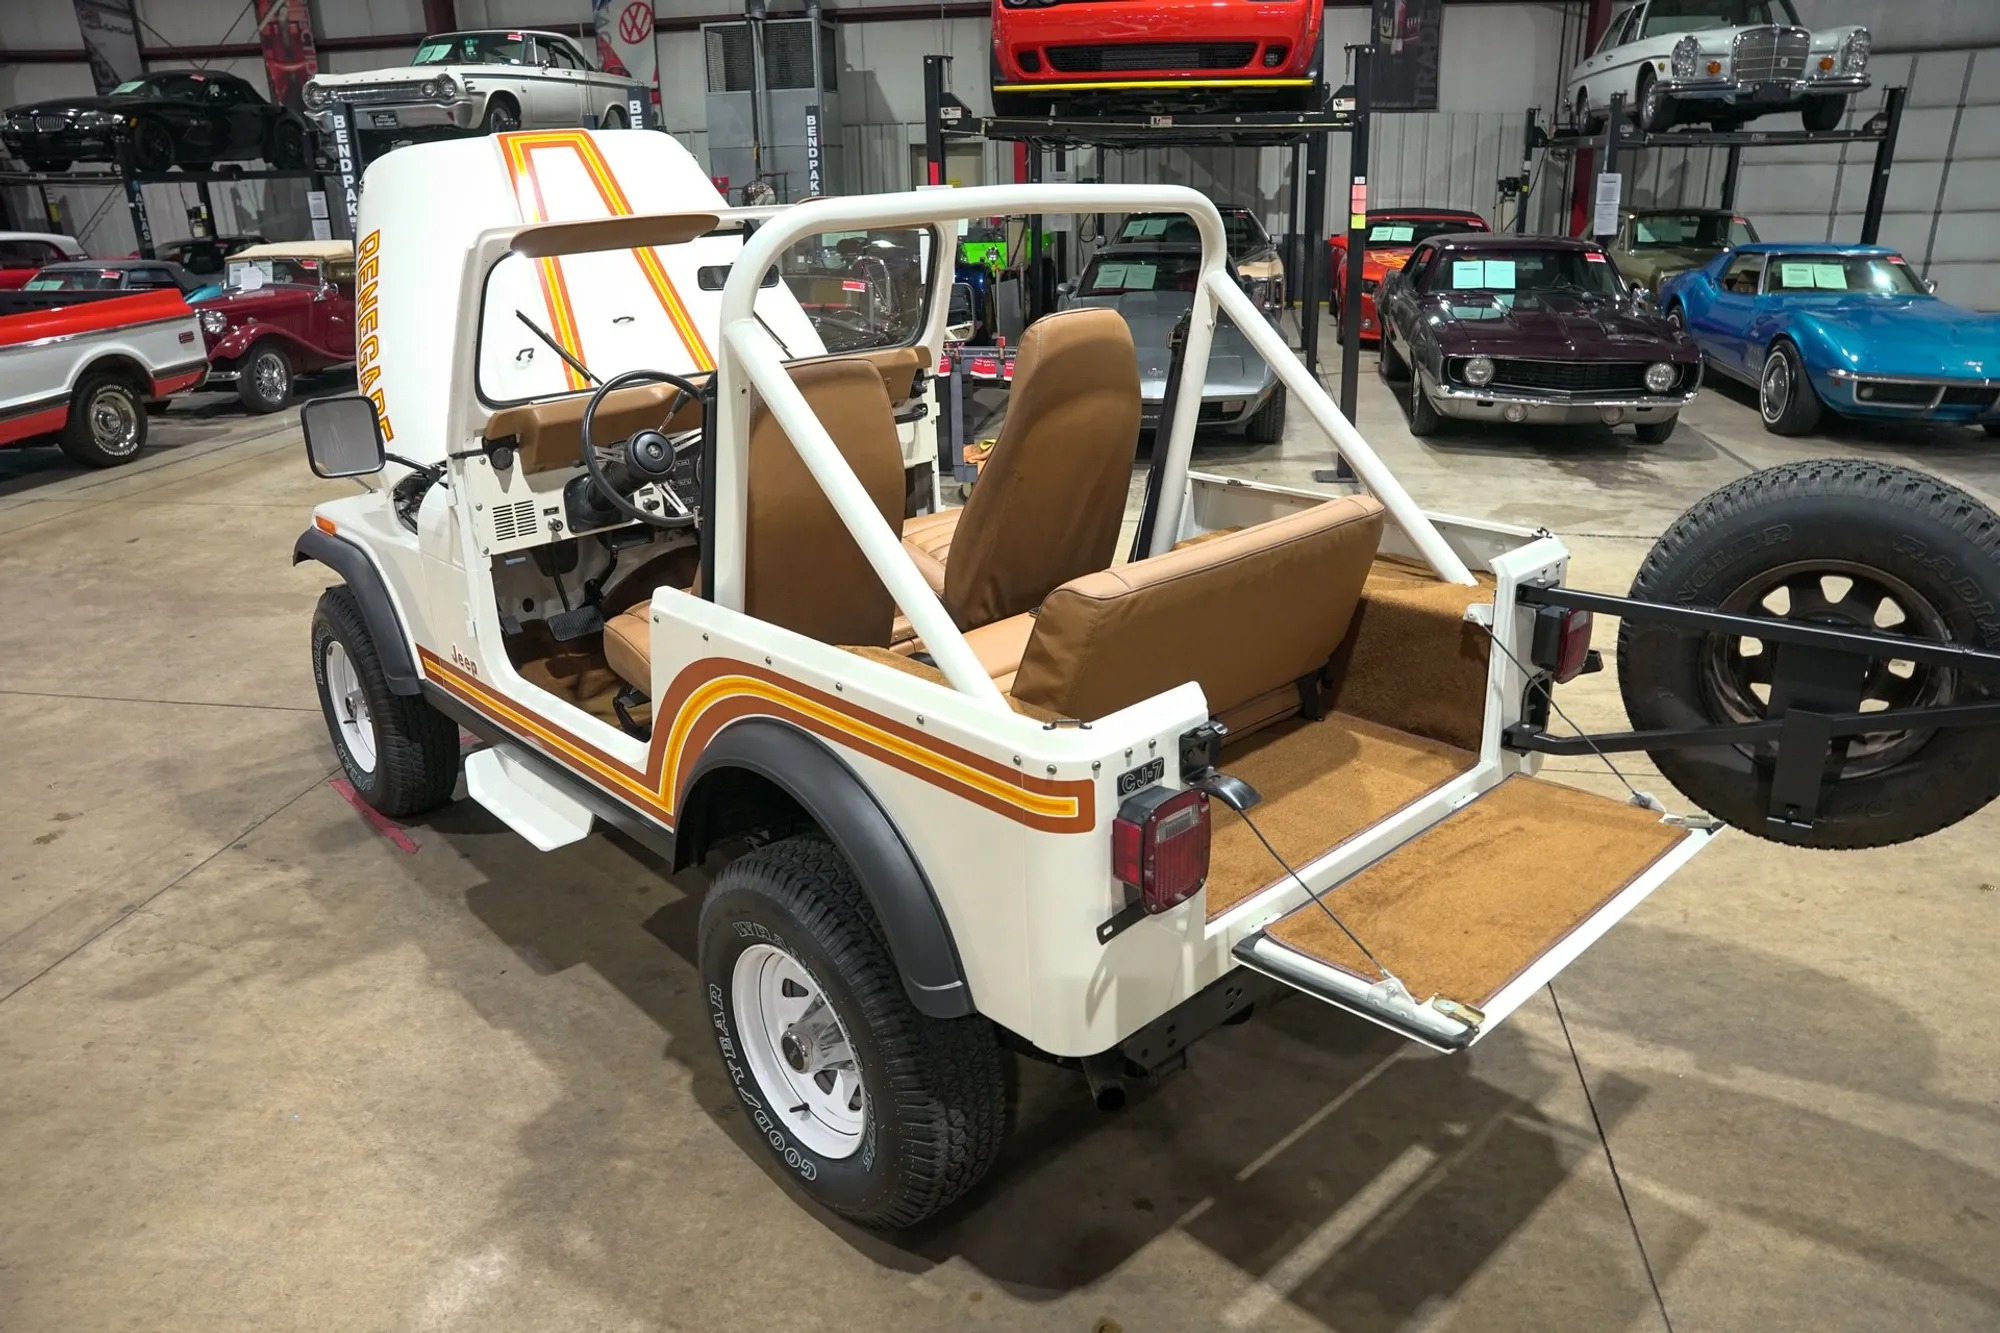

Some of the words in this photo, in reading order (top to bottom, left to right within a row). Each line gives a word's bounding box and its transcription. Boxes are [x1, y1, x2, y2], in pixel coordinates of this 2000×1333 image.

[333, 114, 358, 216] BENDPAK
[806, 115, 820, 191] BENDPAK
[135, 192, 151, 241] ATLAS
[451, 644, 478, 677] Jeep
[709, 983, 817, 1181] GOODYEAR
